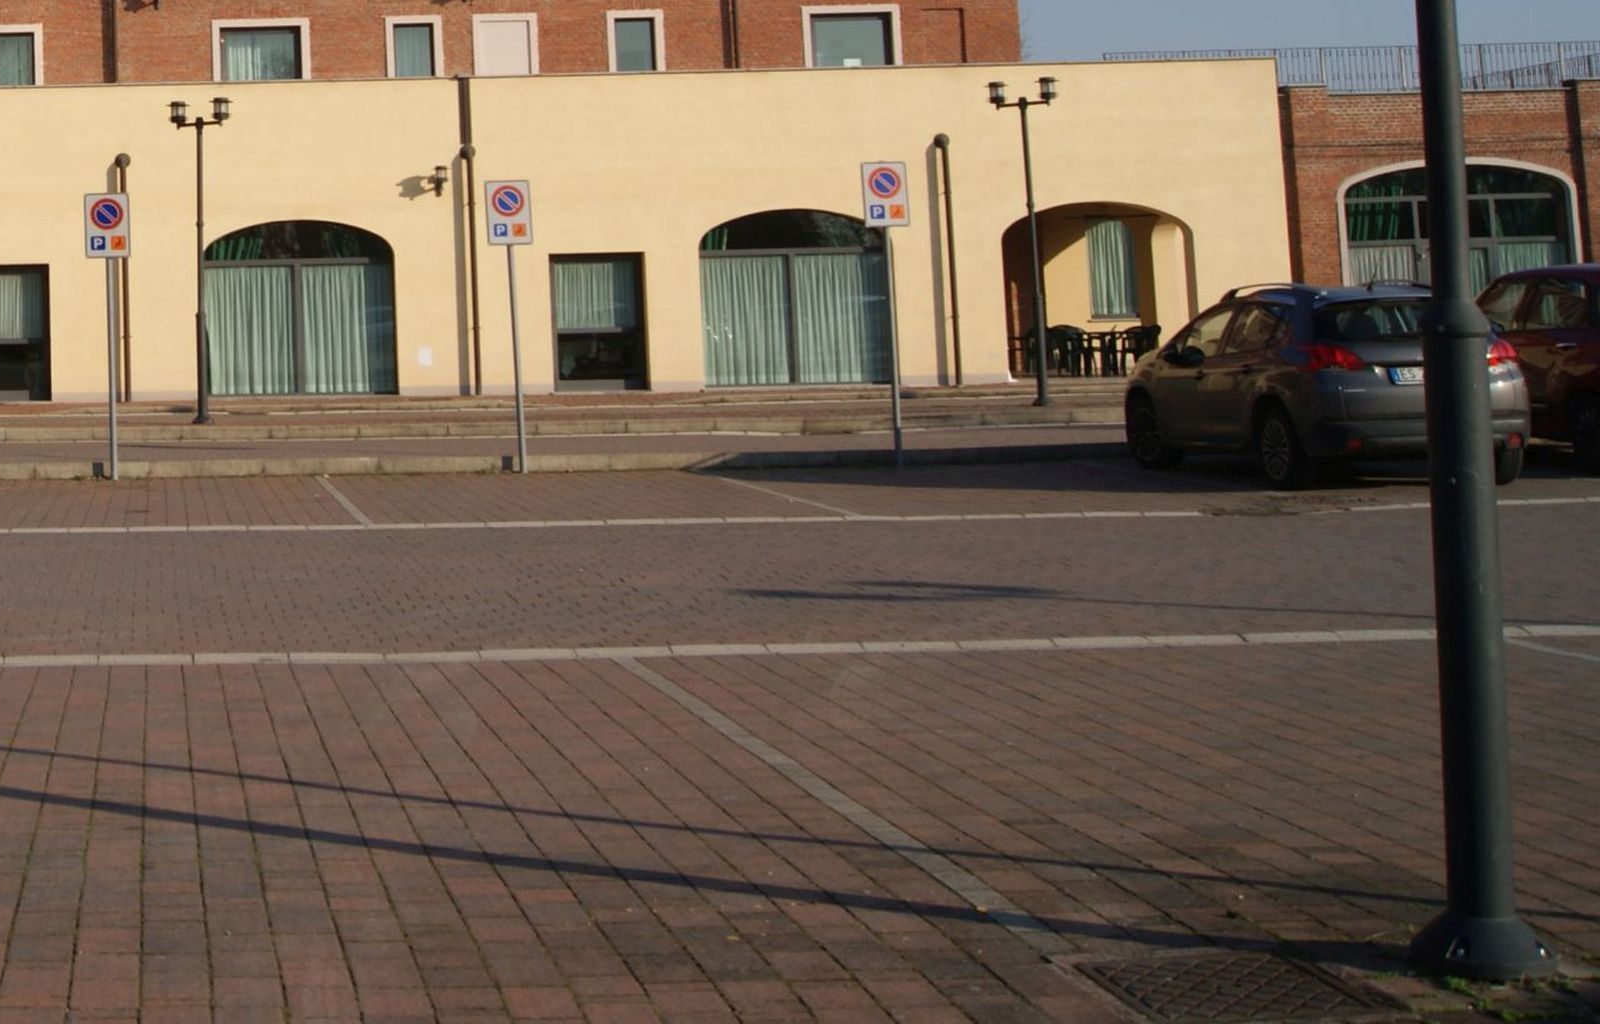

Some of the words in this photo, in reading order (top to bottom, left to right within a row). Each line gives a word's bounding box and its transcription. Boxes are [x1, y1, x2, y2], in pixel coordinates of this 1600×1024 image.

[872, 206, 883, 218] P
[496, 225, 506, 236] P
[93, 237, 103, 249] P
